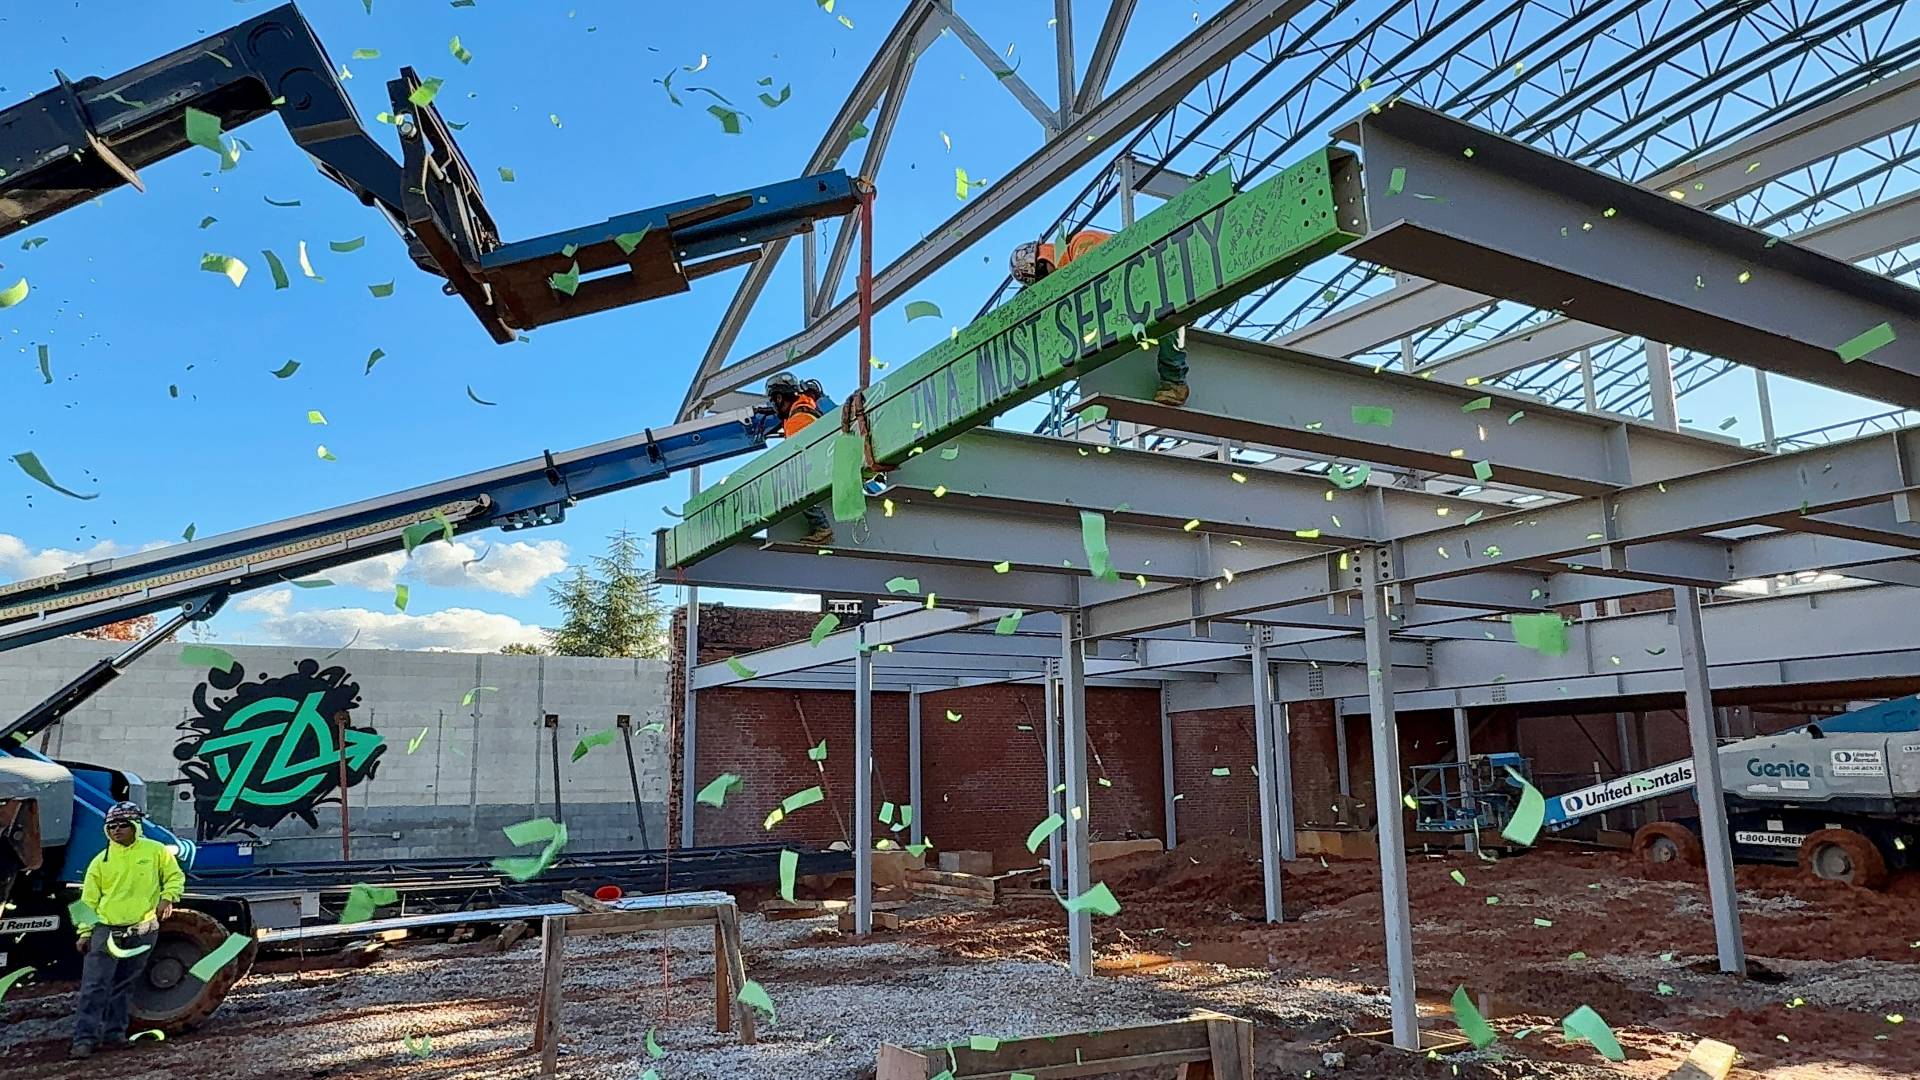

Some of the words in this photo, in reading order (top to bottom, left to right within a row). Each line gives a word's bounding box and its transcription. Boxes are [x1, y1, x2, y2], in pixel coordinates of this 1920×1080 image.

[700, 499, 727, 550] MUST
[733, 477, 763, 534] PLAY
[911, 376, 939, 443] IN
[945, 363, 963, 426] A
[976, 312, 1044, 412] MUST
[1055, 274, 1119, 368] SEE
[1124, 205, 1225, 328] CITY
[1746, 758, 1811, 778] Genie
[1585, 781, 1633, 806] United
[6, 918, 53, 930] Rentals
